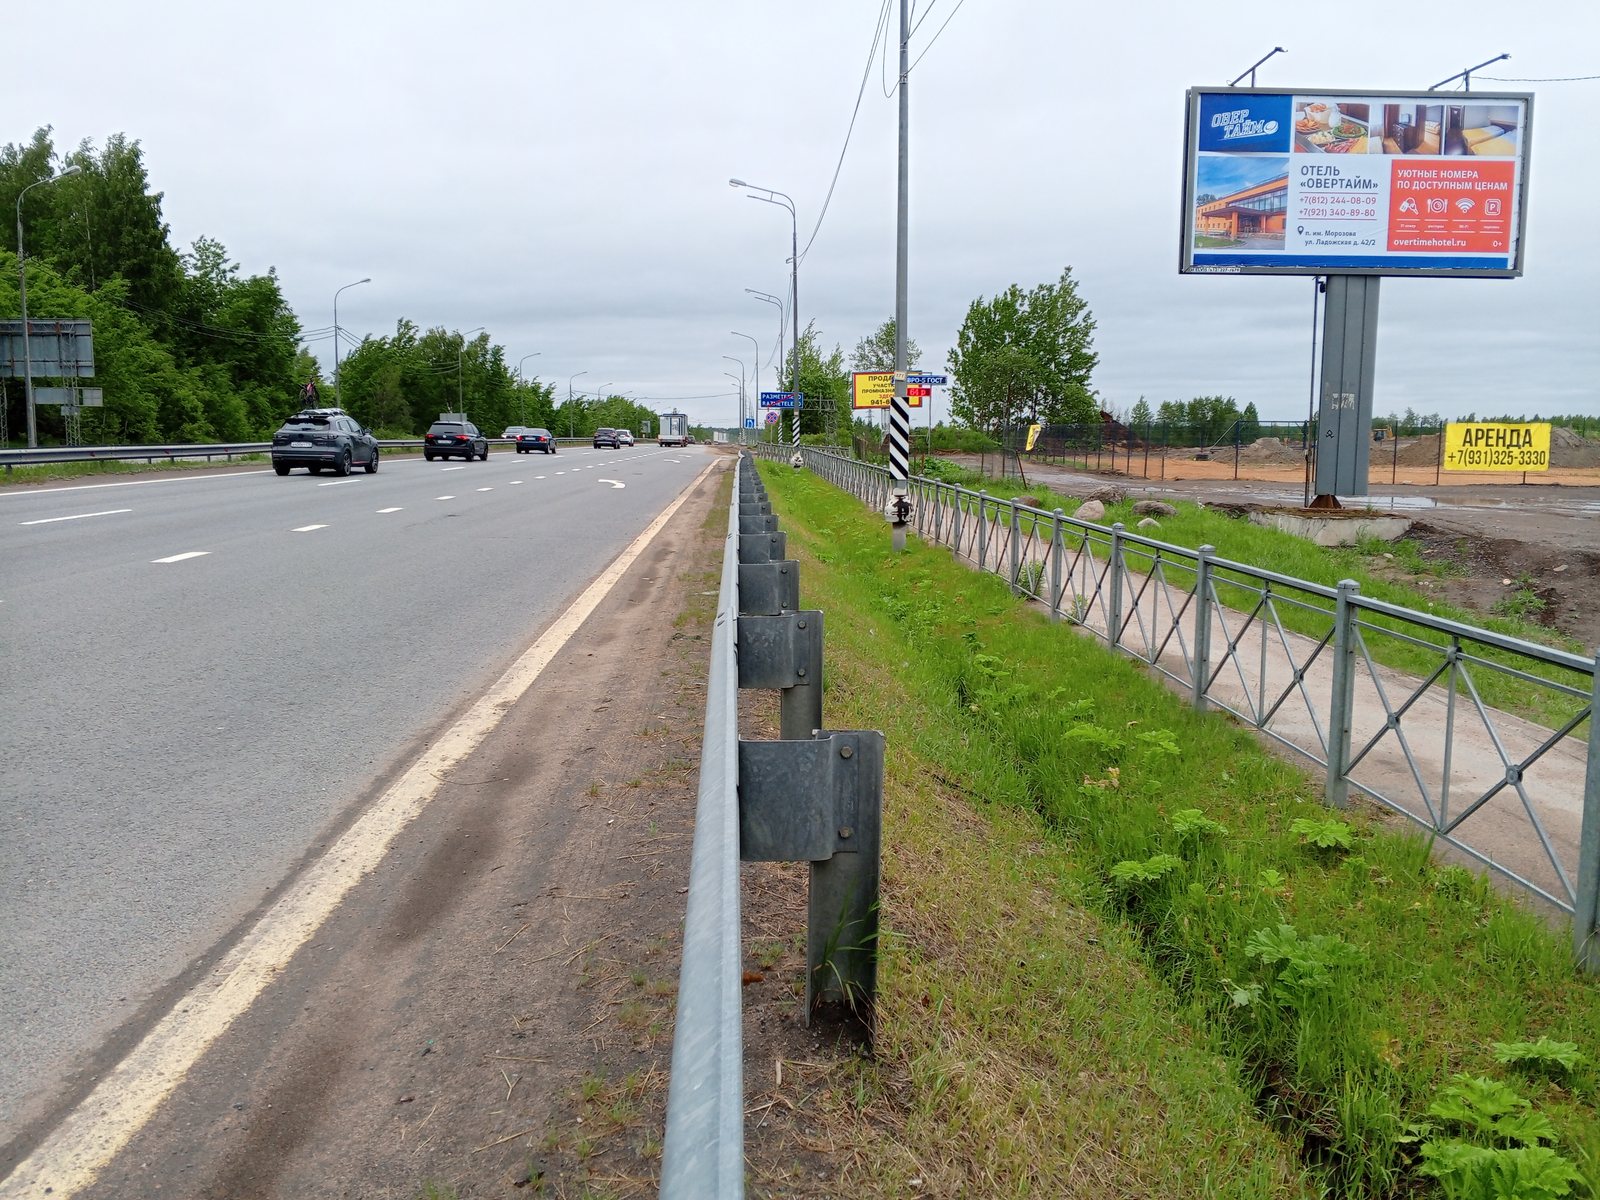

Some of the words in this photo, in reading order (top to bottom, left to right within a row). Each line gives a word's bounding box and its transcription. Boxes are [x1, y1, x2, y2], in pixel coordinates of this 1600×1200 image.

[1211, 108, 1250, 128] ОВЕР
[1300, 165, 1341, 176] ОТЕЛЬ
[1397, 169, 1438, 178] УЮТНЫЕ
[1440, 170, 1479, 179] НОМЕРА
[1300, 175, 1379, 189] «ОВЕРТАЙМ»
[1397, 181, 1411, 189] ПО
[1412, 181, 1473, 190] ДОСТУПНЫМ
[1474, 182, 1508, 191] ЦЕНАМ
[1299, 196, 1328, 206] +7(812)
[1330, 196, 1377, 205] 244-08-09
[1299, 208, 1327, 217] +7(921)
[1329, 208, 1376, 217] 340-89-80
[1324, 229, 1357, 237] Морозова
[1316, 238, 1352, 246] Ладожская
[1393, 237, 1467, 247] overtimehotel.ru
[1462, 428, 1533, 449] АРЕНДА
[1447, 448, 1546, 467] +7(931)325-3330
